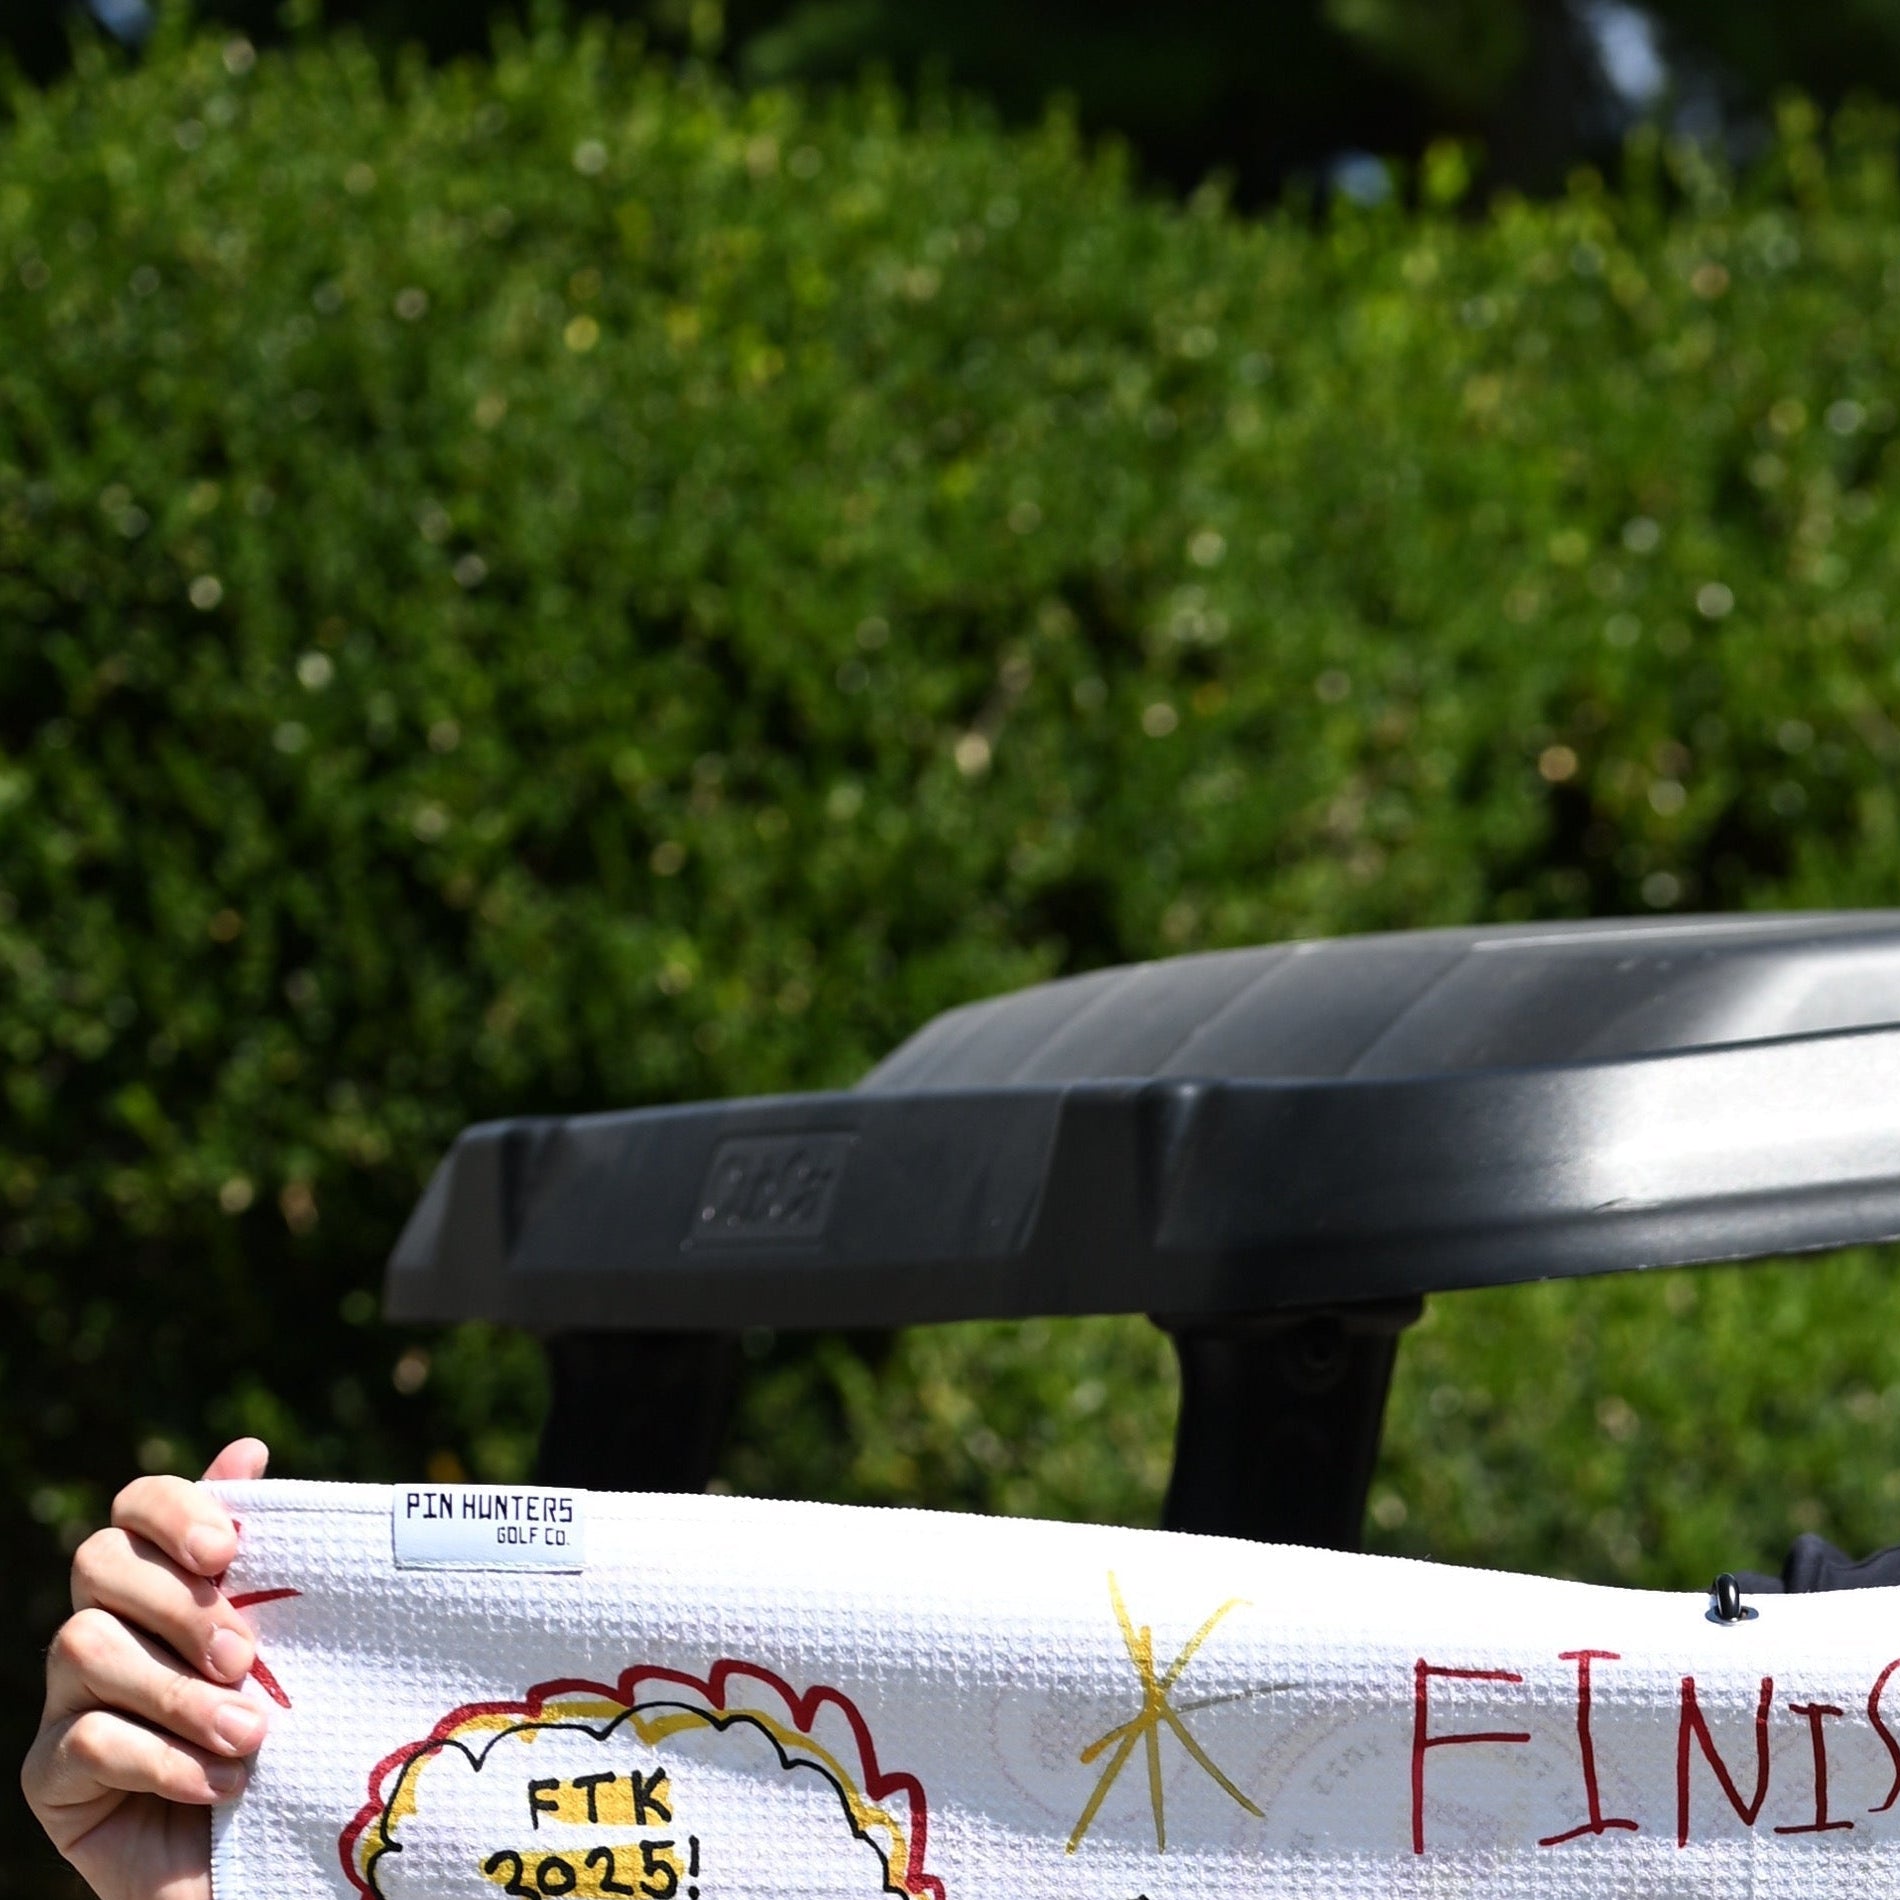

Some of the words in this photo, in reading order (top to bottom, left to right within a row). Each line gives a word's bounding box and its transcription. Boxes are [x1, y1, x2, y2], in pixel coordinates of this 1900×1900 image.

[406, 1492, 453, 1520] PIN
[462, 1493, 573, 1523] HUNTERS
[497, 1525, 539, 1545] GOLF
[545, 1527, 571, 1547] CO.
[527, 1767, 673, 1830] FTK
